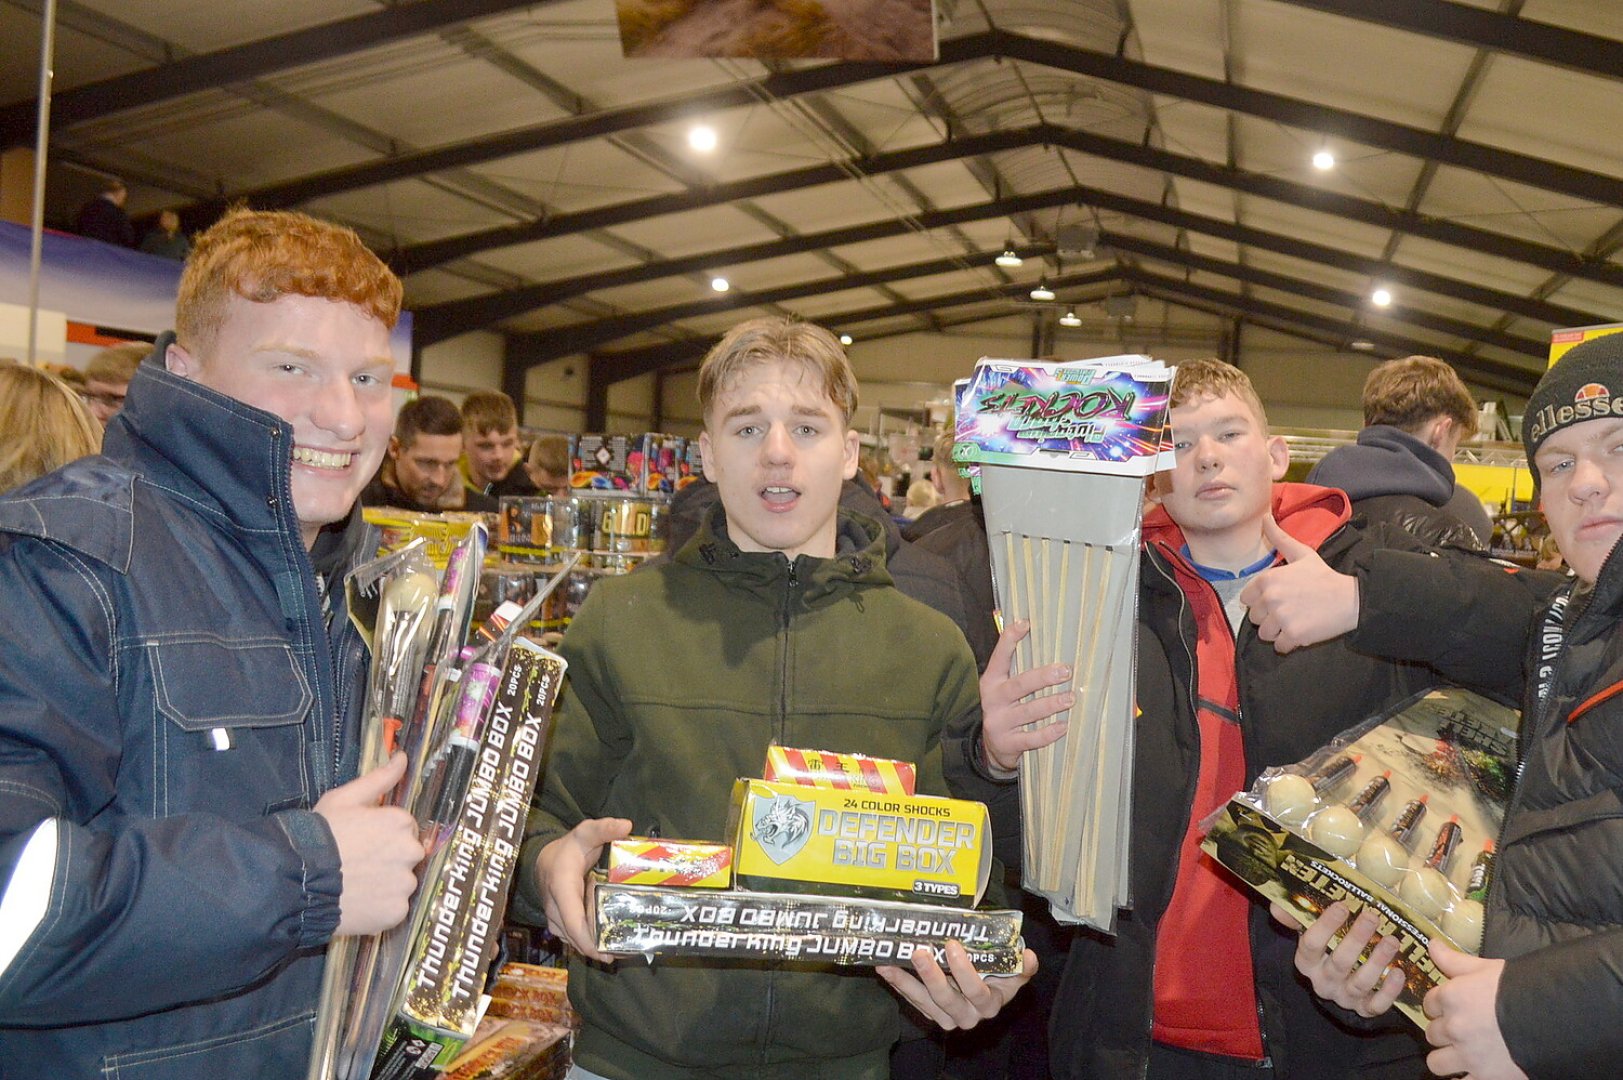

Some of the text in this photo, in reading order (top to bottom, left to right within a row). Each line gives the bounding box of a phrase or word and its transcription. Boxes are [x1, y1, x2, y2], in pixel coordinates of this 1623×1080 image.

[976, 387, 1136, 421] ROCKETS
[507, 665, 523, 697] 20PCS
[536, 675, 551, 707] 20PCS
[467, 747, 502, 829] JUMBO
[488, 701, 513, 748] BOX
[498, 758, 530, 839] JUMBO
[517, 712, 542, 762] BOX
[843, 798, 951, 818] 24 COLOR SHOCKS
[817, 809, 976, 849] DEFENDER
[832, 838, 957, 875] BIG BOX
[914, 881, 959, 896] 3 TYPES
[1309, 860, 1430, 946] OFESSIONAL BALLROCKETS
[680, 904, 737, 925] BOX
[739, 908, 829, 931] JUMBO
[806, 936, 894, 959] JUMBO
[966, 953, 995, 963] 0PCS
